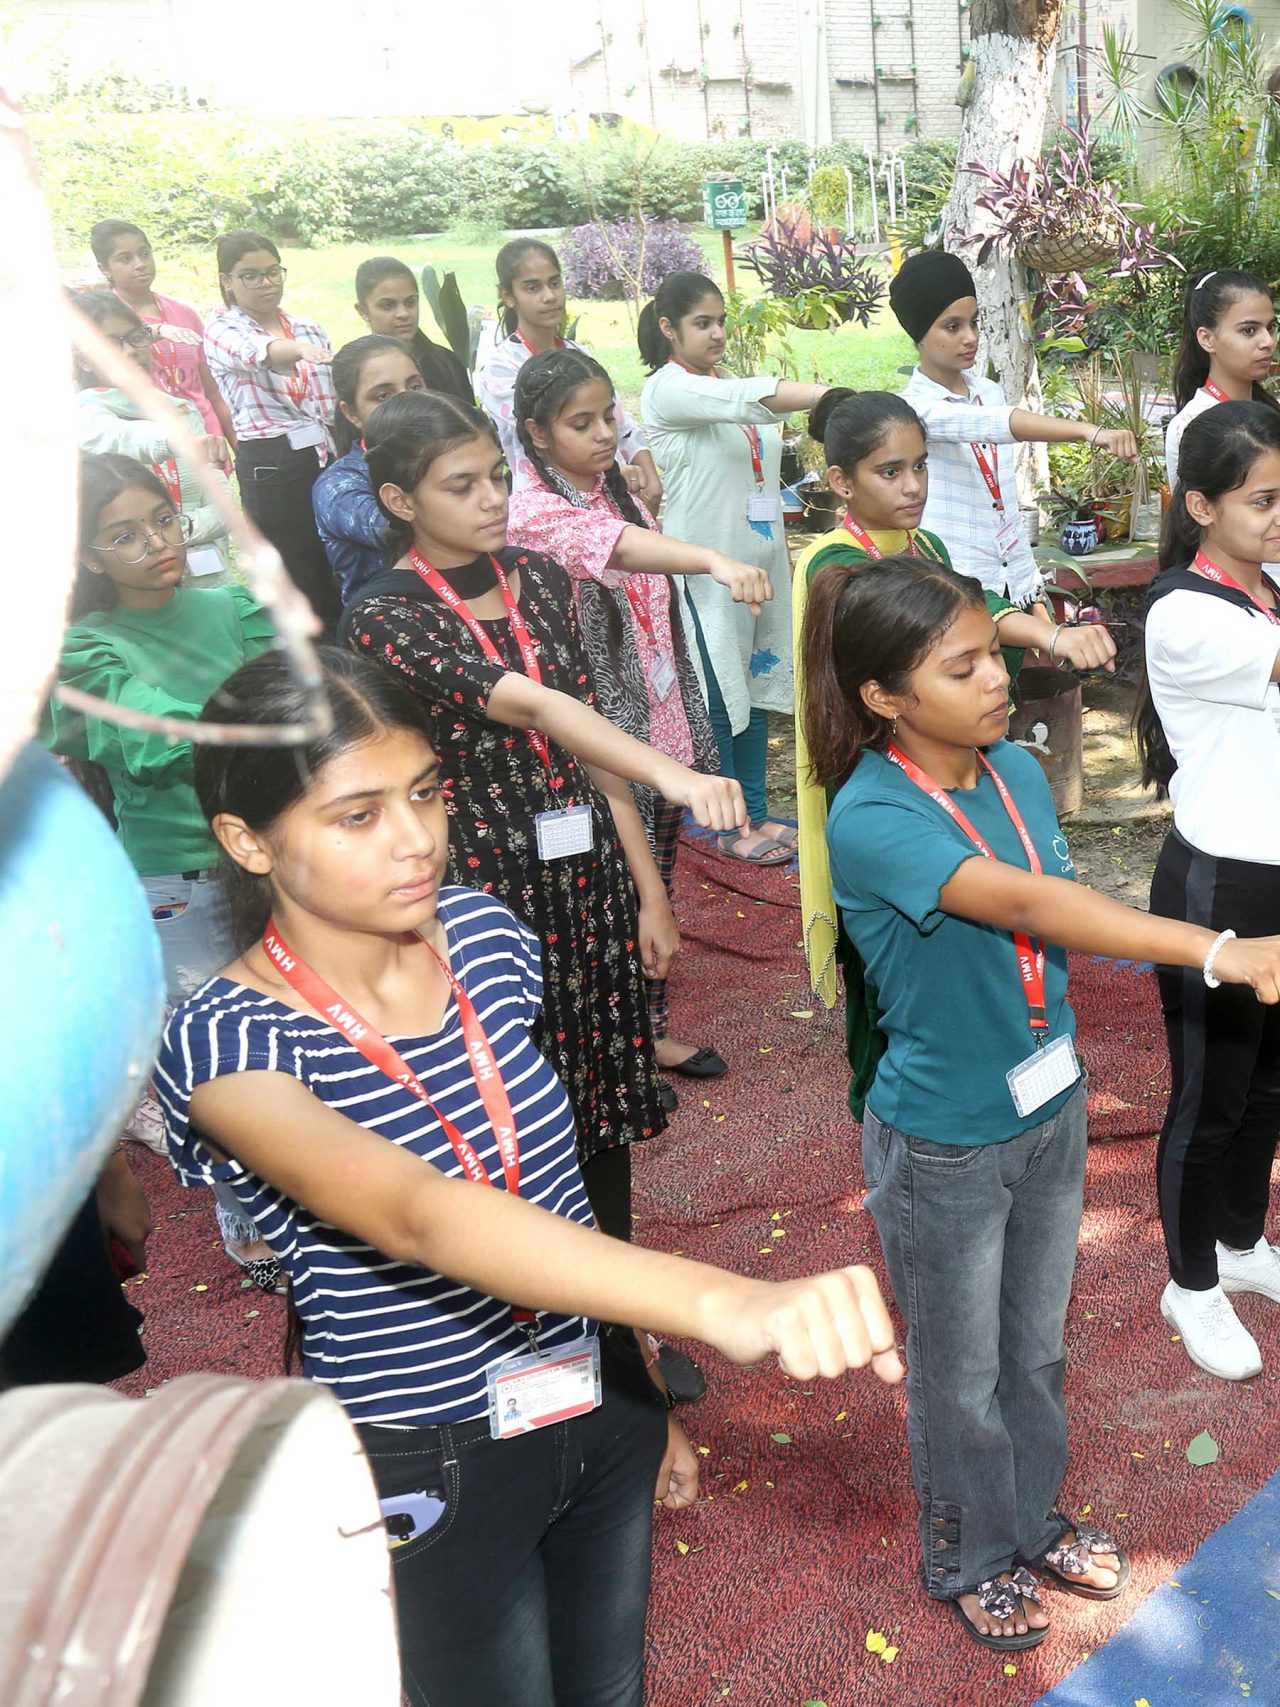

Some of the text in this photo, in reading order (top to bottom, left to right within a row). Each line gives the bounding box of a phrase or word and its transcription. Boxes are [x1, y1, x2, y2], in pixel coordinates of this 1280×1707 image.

[848, 521, 865, 537] HMV
[412, 556, 431, 576] HMV
[1202, 564, 1222, 582] HMV
[497, 568, 509, 591] HMV
[439, 586, 460, 607] HMV
[509, 607, 523, 629] HMV
[634, 600, 646, 618] HMV
[469, 618, 486, 640] HMV
[523, 645, 536, 668] HMV
[527, 729, 543, 752] HMV
[929, 791, 955, 814] HMV
[1019, 826, 1034, 854] HMV
[266, 936, 296, 973] HMV
[1019, 956, 1034, 982] HMV
[326, 1003, 369, 1041] HMV
[470, 1040, 495, 1081] HMV
[499, 1126, 517, 1167] HMV
[457, 1143, 484, 1182] HMV
